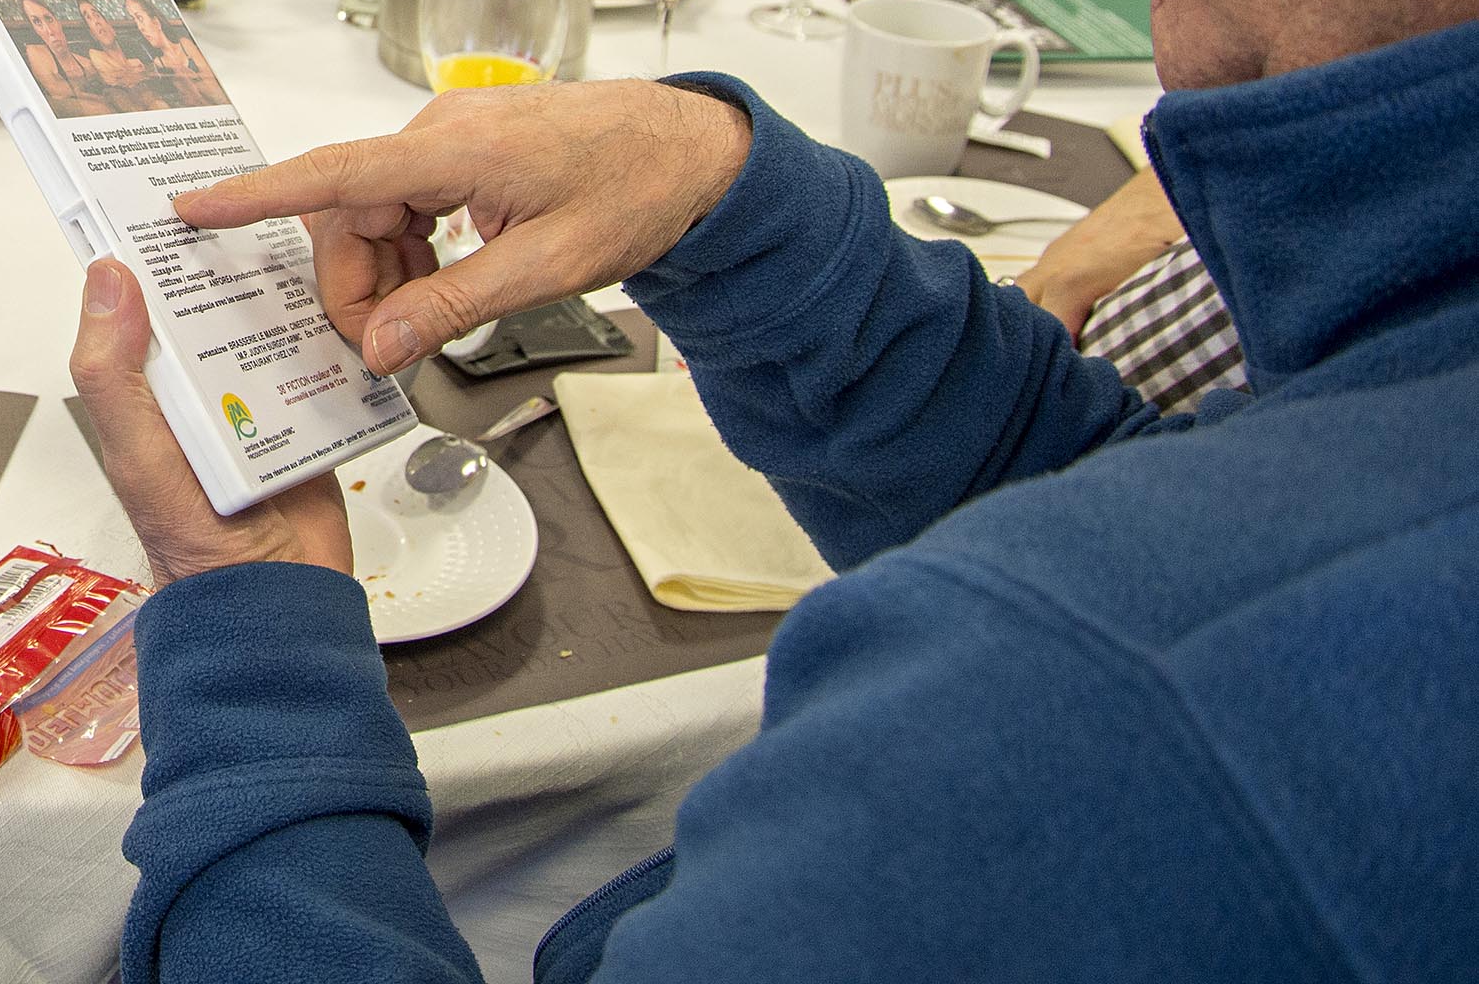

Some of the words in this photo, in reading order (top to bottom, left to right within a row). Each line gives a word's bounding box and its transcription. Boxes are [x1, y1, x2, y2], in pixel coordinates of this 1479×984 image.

[116, 141, 150, 154] gratuits
[158, 137, 186, 149] simple
[181, 133, 225, 147] présentation
